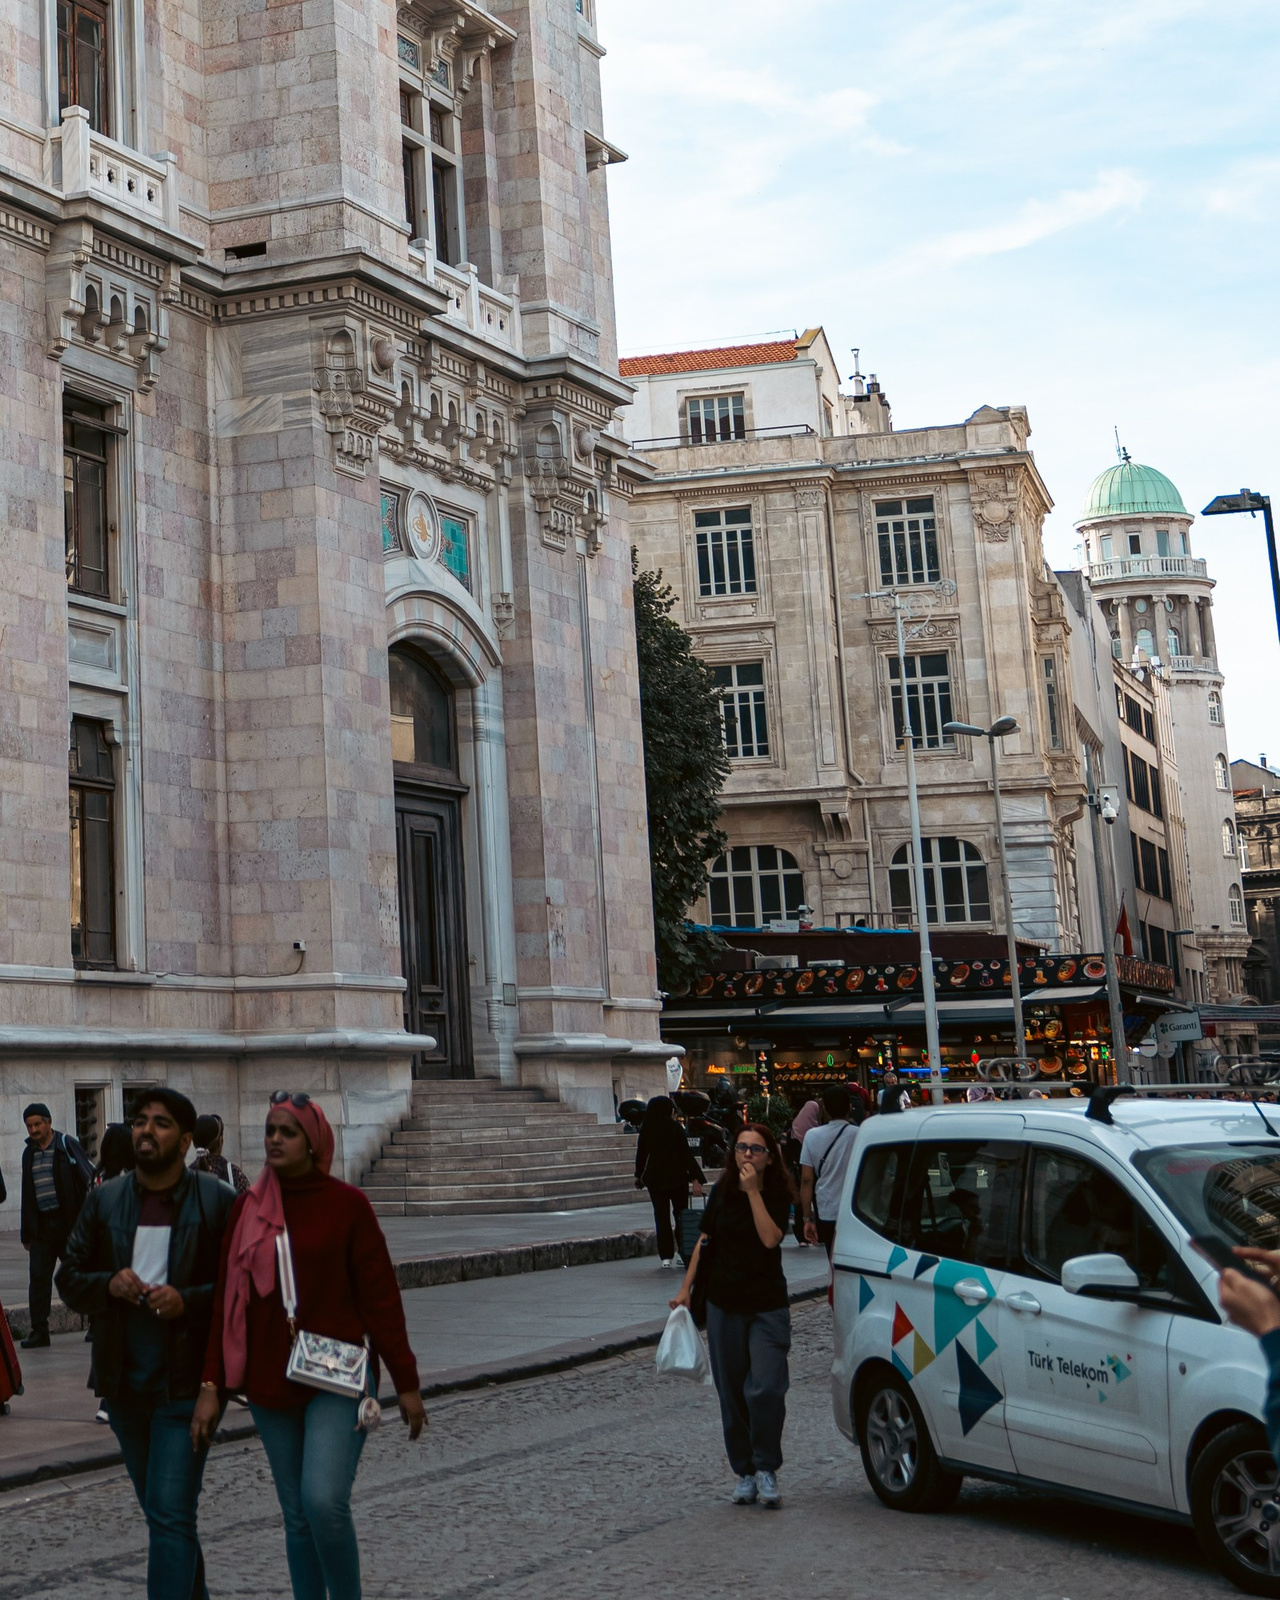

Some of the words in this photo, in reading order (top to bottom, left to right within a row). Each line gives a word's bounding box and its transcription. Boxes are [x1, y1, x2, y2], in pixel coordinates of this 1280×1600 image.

[1168, 1021, 1197, 1032] Garanti
[1028, 1350, 1054, 1371] Türk
[1056, 1356, 1109, 1384] Telekom
